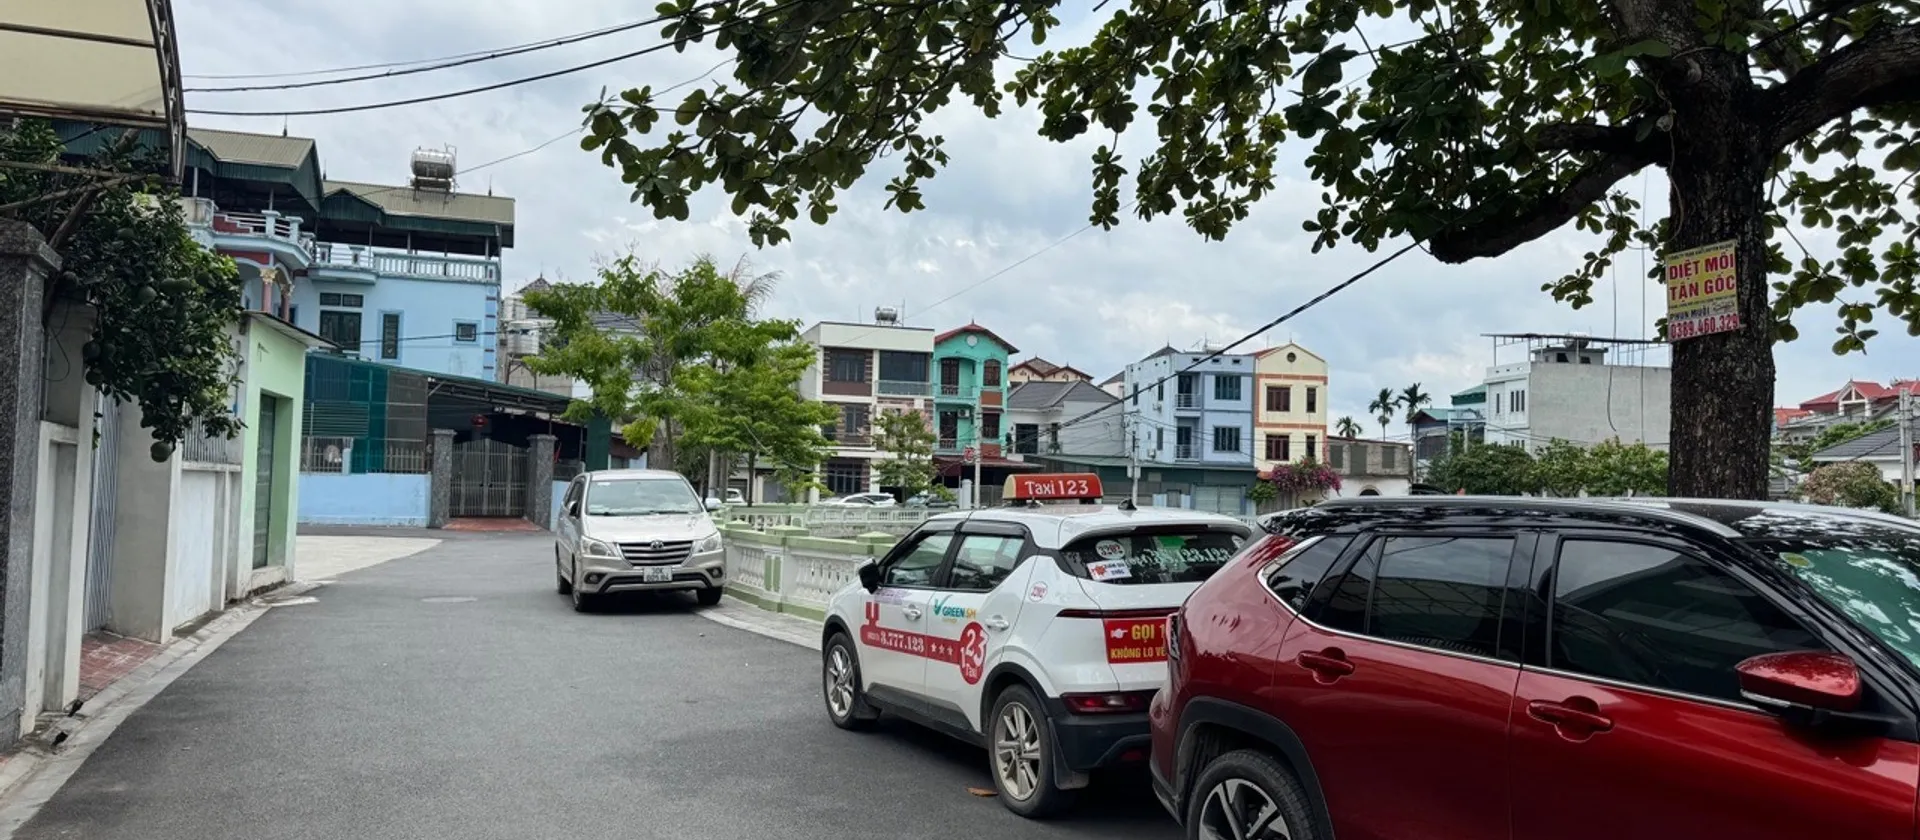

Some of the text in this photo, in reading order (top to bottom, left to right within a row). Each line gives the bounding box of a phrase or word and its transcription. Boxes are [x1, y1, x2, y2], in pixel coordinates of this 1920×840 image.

[1670, 281, 1699, 303] TẬN
[1704, 271, 1735, 295] GỐC
[1024, 480, 1089, 495] Taxi 123
[942, 606, 965, 618] GREEN
[880, 630, 925, 653] 3.777.123
[1131, 624, 1155, 643] GỌI
[1110, 645, 1141, 659] KHÔNG
[1143, 647, 1153, 658] LO
